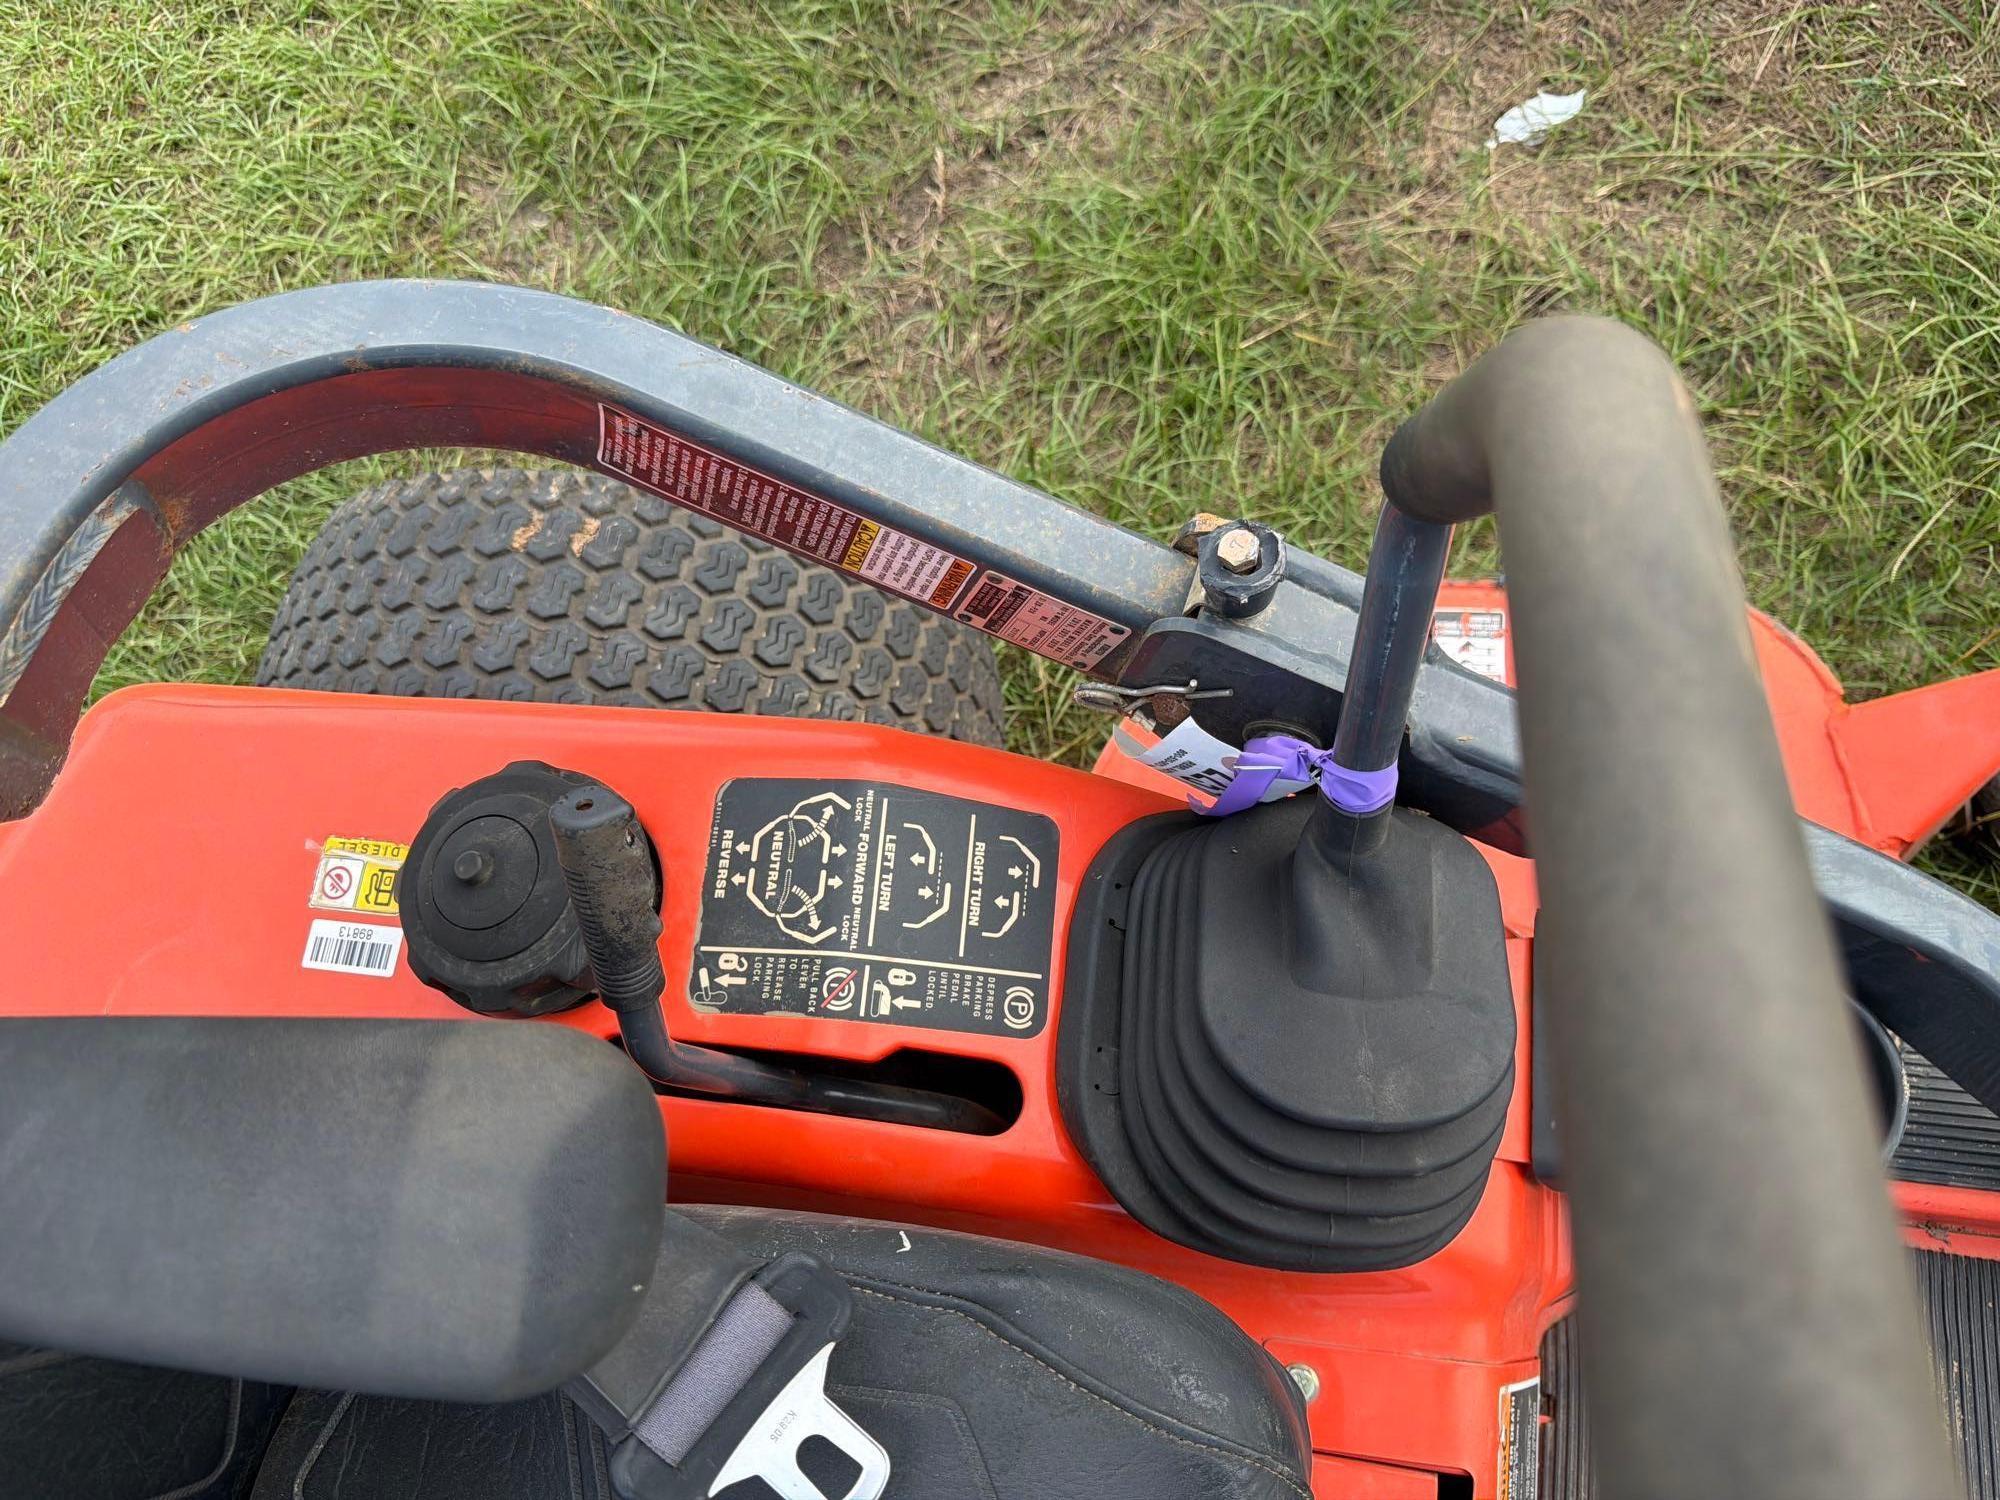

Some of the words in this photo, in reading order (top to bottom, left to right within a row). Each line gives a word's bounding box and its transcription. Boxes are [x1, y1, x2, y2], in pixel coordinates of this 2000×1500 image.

[734, 480, 745, 491] not
[736, 472, 747, 483] Do
[731, 488, 743, 502] allow
[744, 483, 759, 500] folding
[758, 492, 770, 503] may
[762, 484, 774, 495] that
[727, 499, 739, 510] any
[743, 502, 754, 512] the
[773, 490, 787, 509] Remove
[787, 495, 800, 508] stop
[802, 501, 814, 512] Set
[817, 502, 830, 513] OR
[753, 501, 769, 519] prevent
[769, 505, 780, 515] any
[794, 508, 811, 527] parking
[827, 508, 843, 527] INJURY
[809, 511, 827, 534] FOLDING
[844, 514, 856, 524] TO
[793, 525, 806, 539] brake
[822, 525, 836, 541] WHEN
[838, 521, 853, 539] AVOID
[878, 530, 892, 547] weaken
[790, 537, 801, 547] and
[814, 538, 831, 558] RAISING
[827, 536, 847, 562] PERSONAL
[844, 530, 874, 569] CAUTION
[874, 545, 885, 554] the
[890, 535, 907, 552] cutting
[886, 549, 897, 558] any
[921, 548, 936, 562] ROPS
[935, 553, 950, 567] Never
[878, 557, 895, 573] portion
[892, 561, 910, 578] drilling
[912, 560, 928, 577] because
[925, 564, 943, 580] modify
[874, 570, 886, 580] may
[916, 582, 931, 595] repair
[931, 568, 965, 605] WARNING
[1071, 619, 1093, 636] MACHINE
[1059, 635, 1076, 648] MODEL
[854, 798, 863, 822] LOCK
[863, 790, 874, 830] NEUTRAL
[339, 842, 400, 857] DIESEL
[883, 834, 896, 869] LEFT
[714, 830, 734, 898] REVERSE
[765, 831, 784, 899] NEUTRAL
[851, 833, 870, 905] FORWARD
[972, 842, 985, 884] RIGHT
[879, 873, 892, 911] TURN
[969, 889, 982, 926] TURN
[339, 926, 373, 940] 89813
[841, 916, 850, 941] LOCK
[850, 906, 862, 951] NEUTRAL
[752, 957, 763, 985] LOCK.
[789, 958, 798, 969] TO
[811, 959, 821, 982] PULL
[762, 957, 774, 999] PARKING
[774, 958, 786, 1000] RELEASE
[799, 959, 809, 989] LEVER
[925, 970, 937, 1012] LOCKED.
[939, 972, 948, 999] UNTIL
[950, 973, 960, 1003] PEDAL
[962, 975, 972, 1006] BRAKE
[808, 988, 818, 1013] BACK
[973, 976, 983, 1017] PARKING
[985, 977, 995, 1021] DEPRESS
